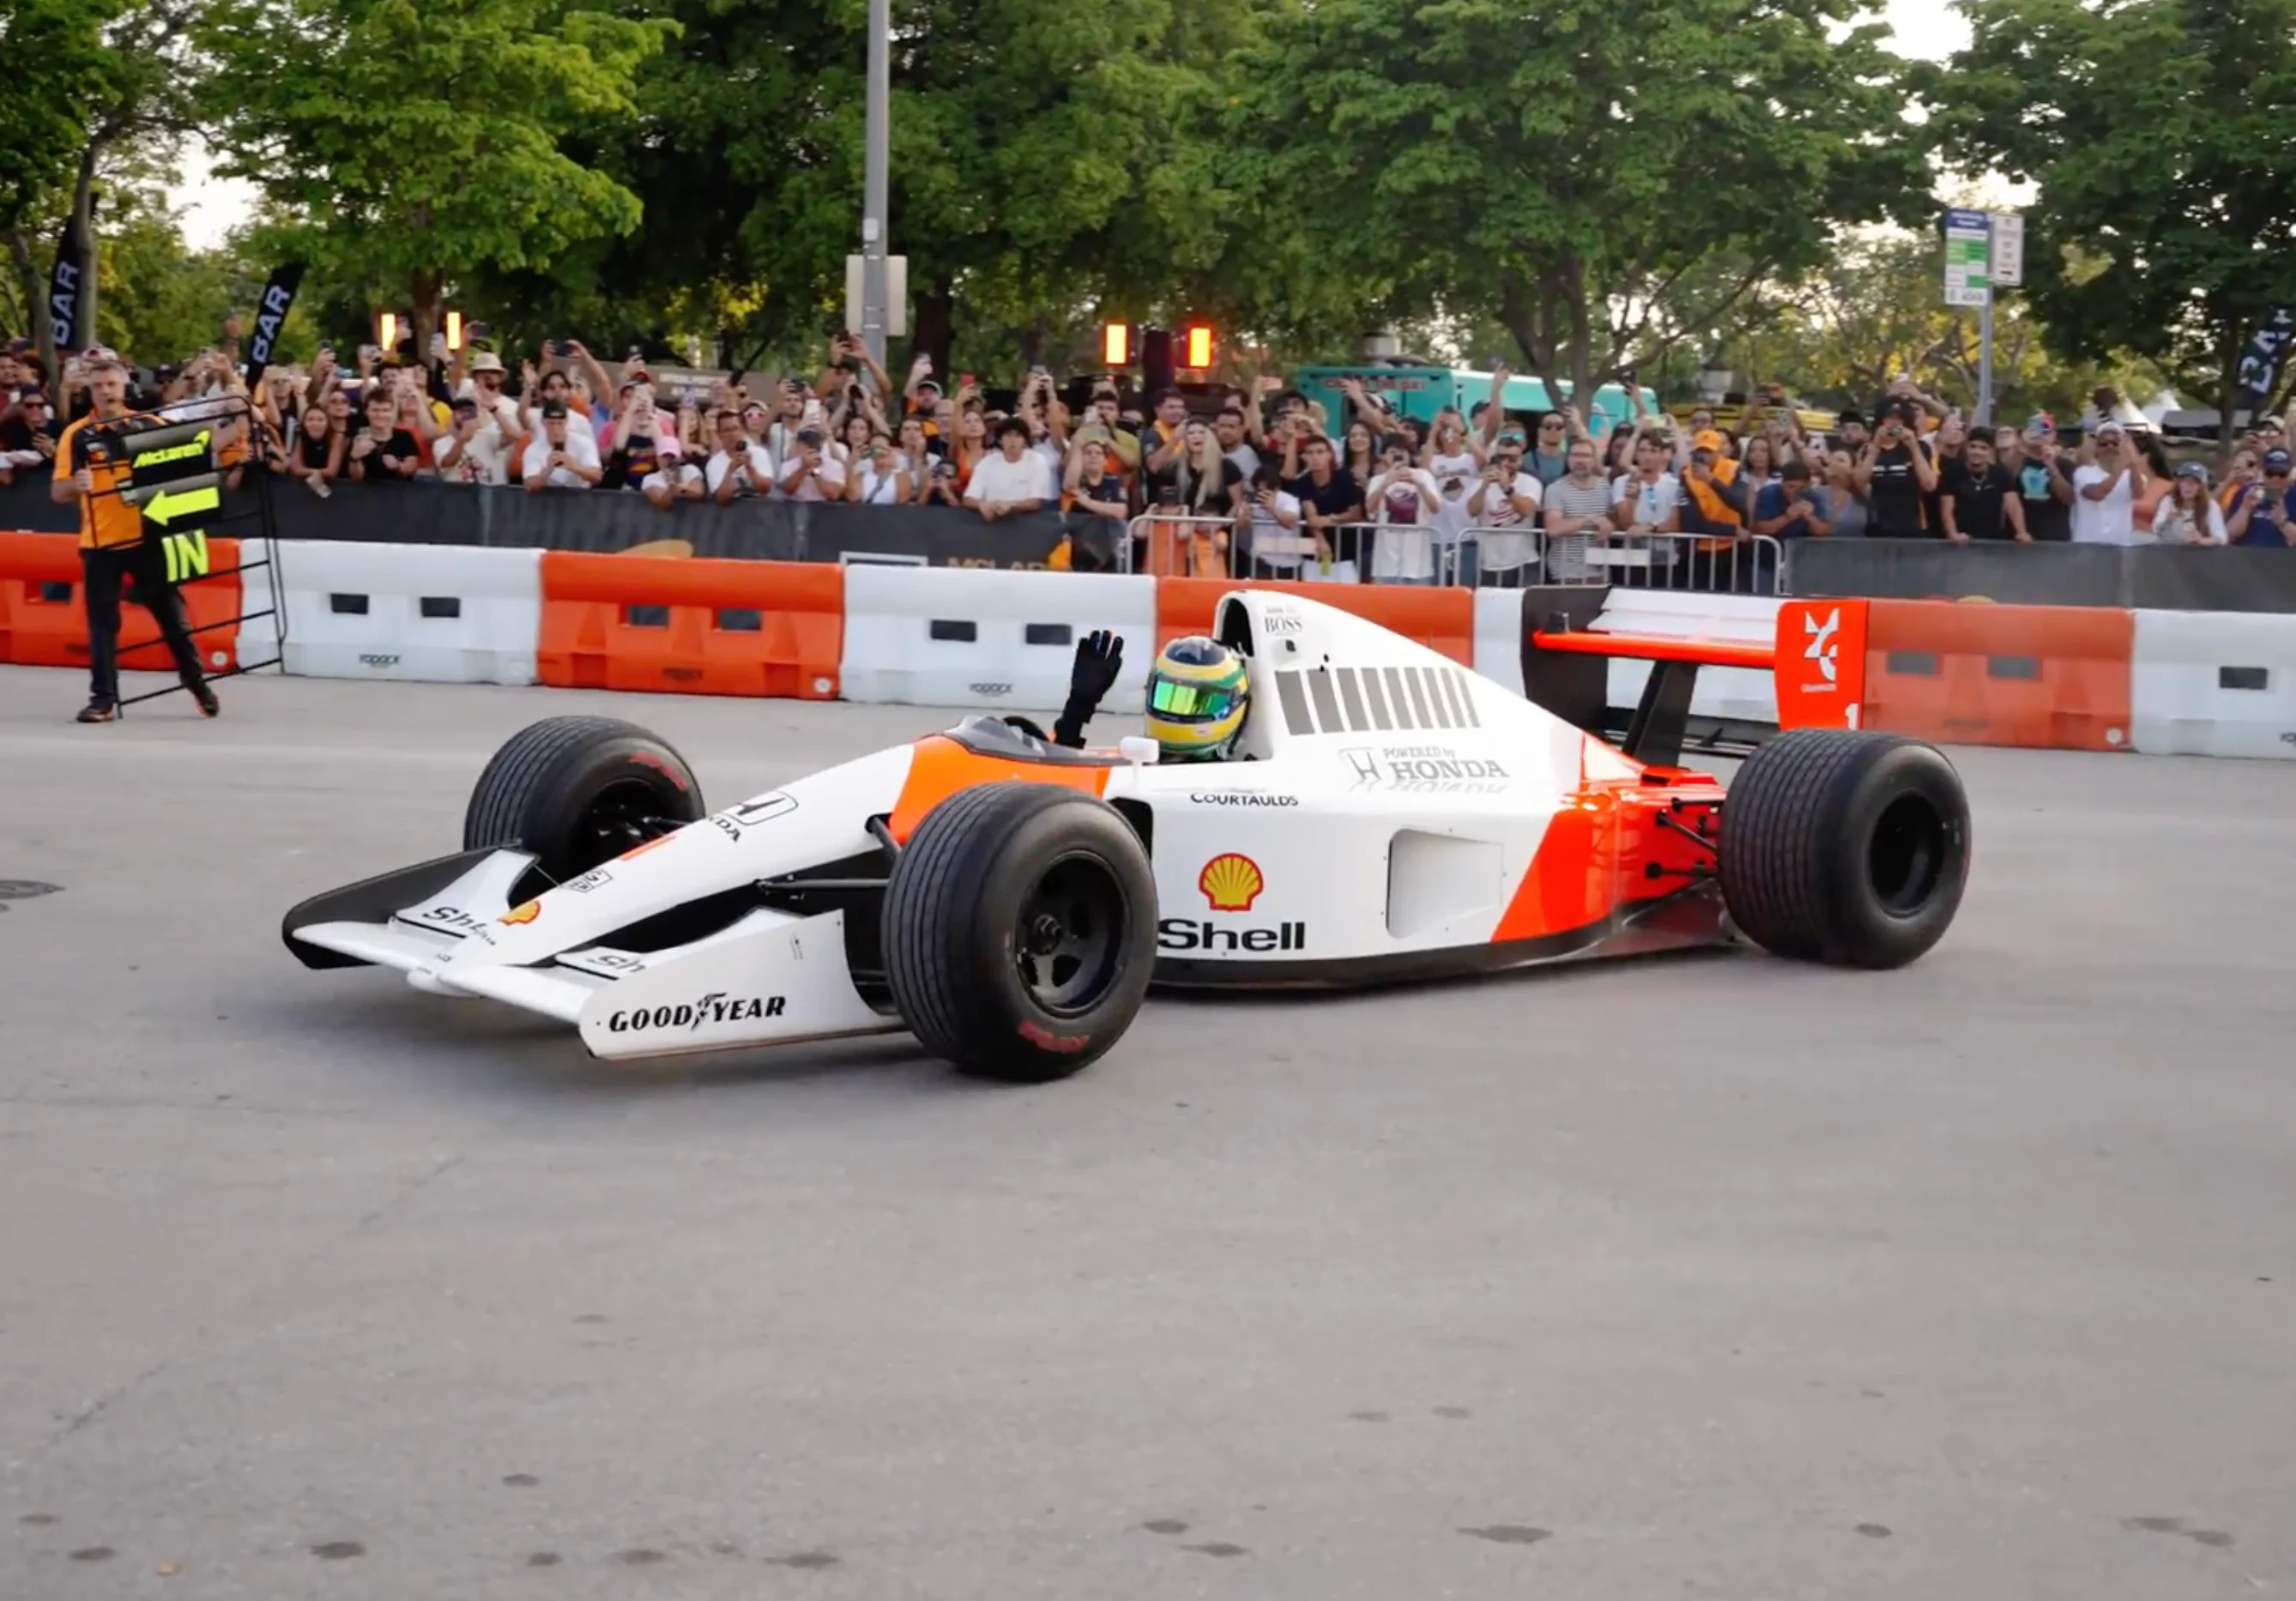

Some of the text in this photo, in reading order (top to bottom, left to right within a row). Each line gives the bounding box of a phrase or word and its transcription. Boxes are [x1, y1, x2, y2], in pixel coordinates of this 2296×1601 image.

[51, 260, 79, 346] BAR
[252, 284, 291, 363] BAR
[161, 529, 208, 582] IN
[1264, 616, 1302, 633] BOSS
[1383, 746, 1441, 758] POWERED
[1387, 759, 1511, 779] HONDA
[1190, 792, 1299, 807] COURTAULDS
[1158, 917, 1305, 951] Shell
